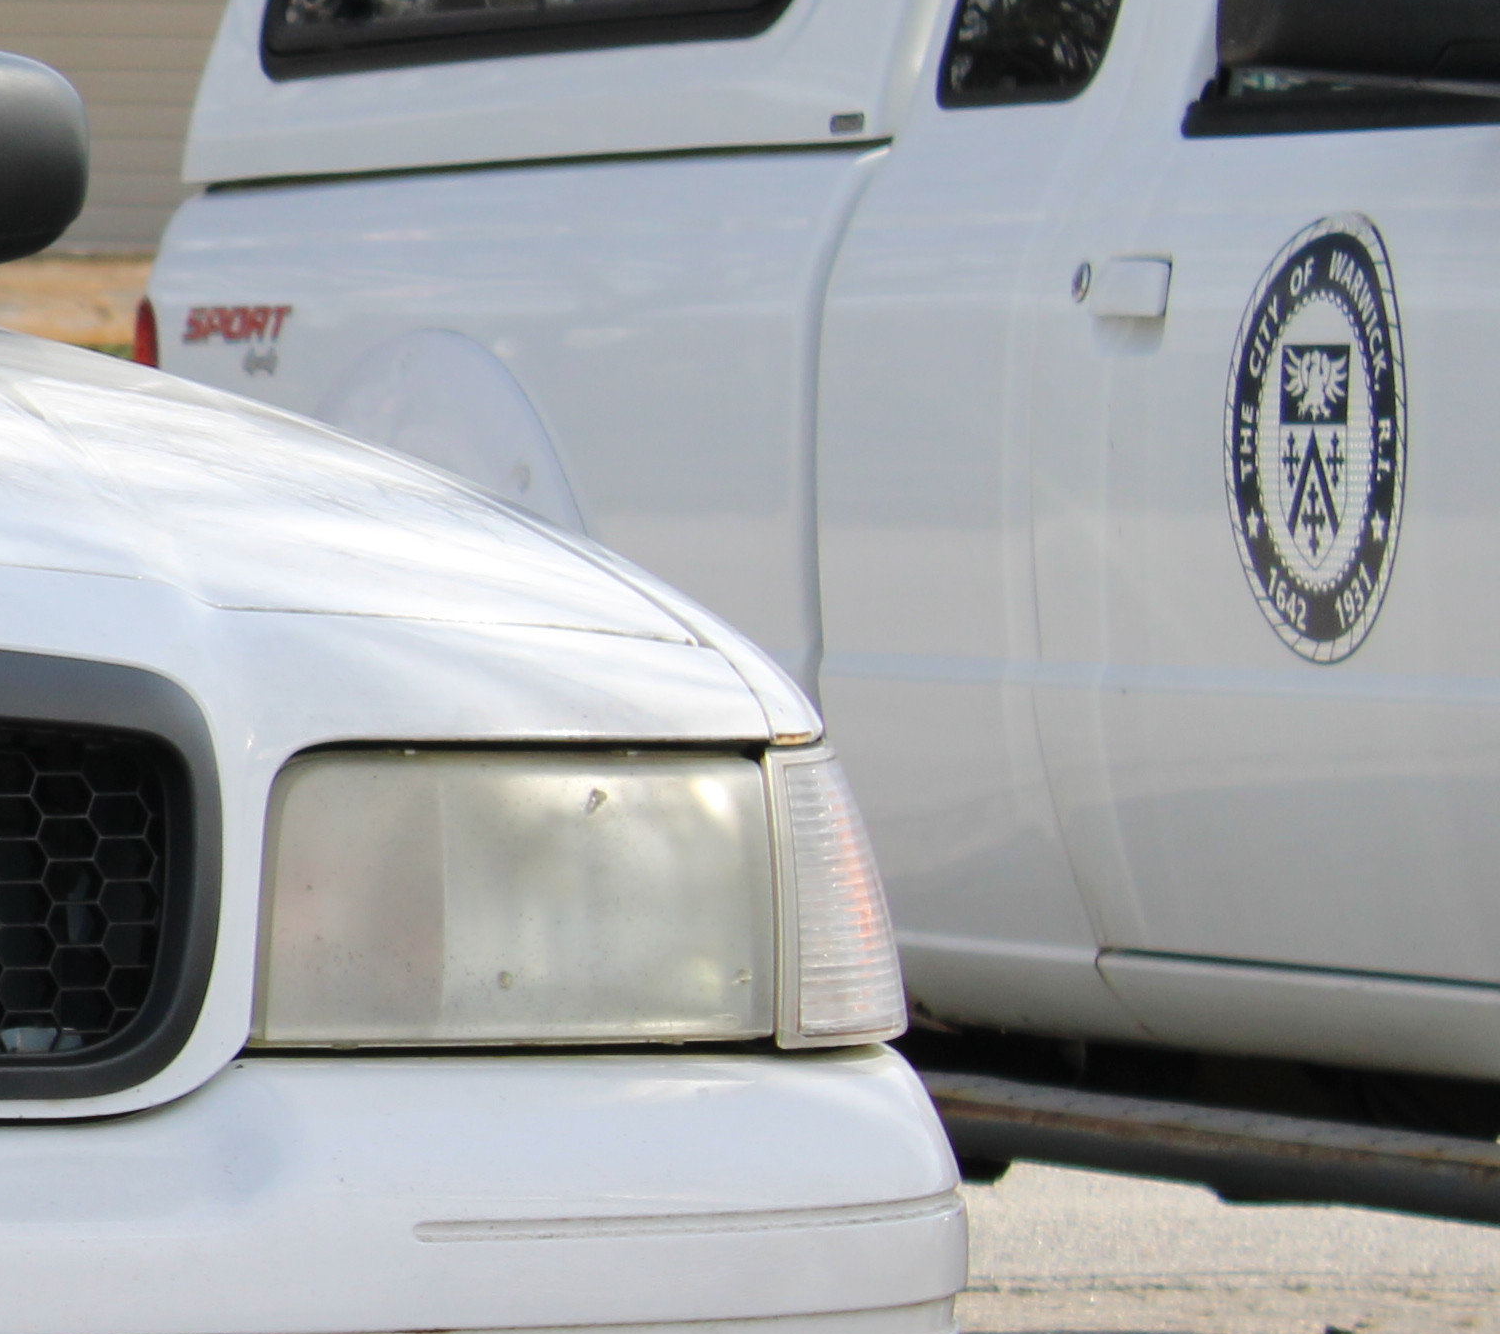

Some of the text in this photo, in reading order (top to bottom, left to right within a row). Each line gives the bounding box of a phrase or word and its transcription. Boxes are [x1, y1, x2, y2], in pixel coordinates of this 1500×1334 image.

[183, 305, 293, 342] SPORT
[1240, 401, 1254, 483] THE
[1250, 294, 1280, 378] CITY
[1290, 255, 1315, 296] OF
[1268, 562, 1372, 630] 1642 1931
